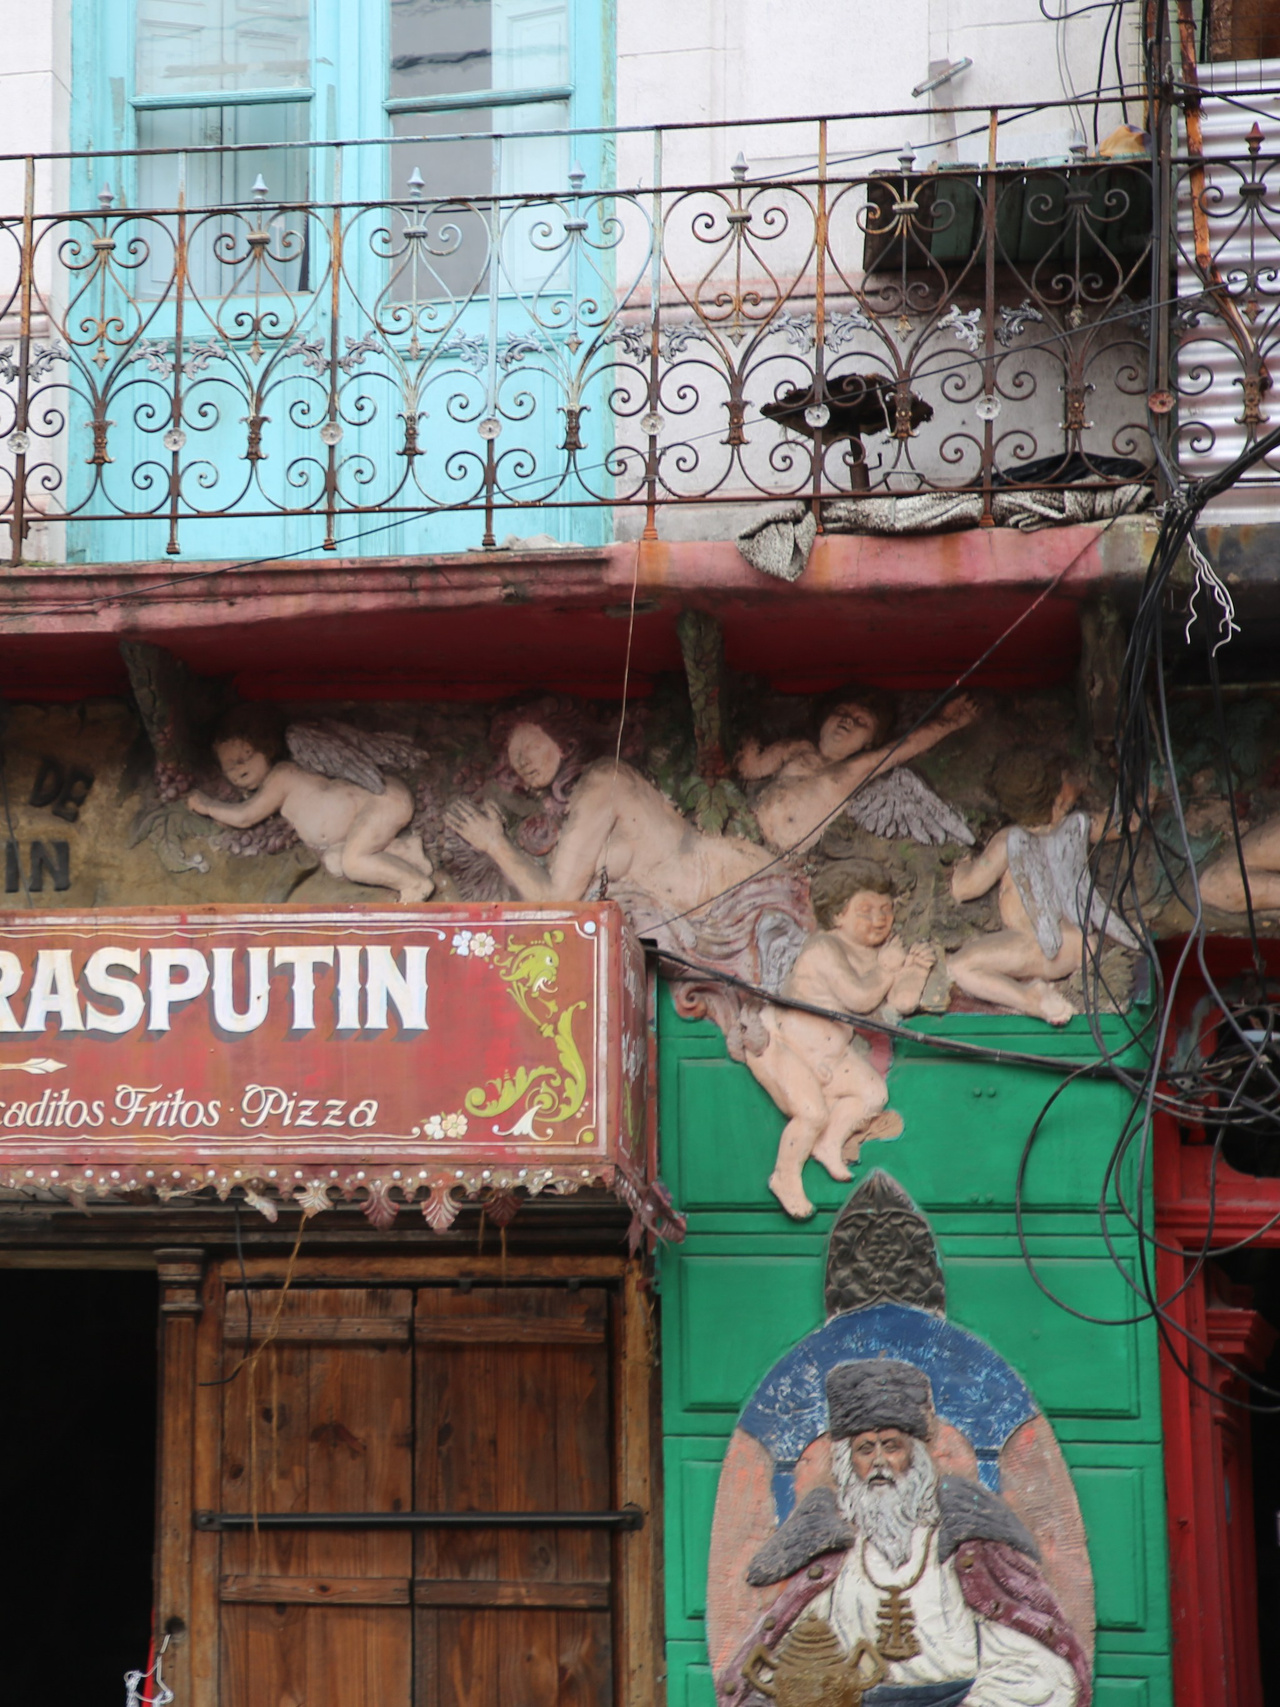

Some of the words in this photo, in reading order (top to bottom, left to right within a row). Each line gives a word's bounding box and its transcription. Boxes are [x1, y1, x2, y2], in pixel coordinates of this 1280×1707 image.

[29, 757, 94, 822] DE
[112, 1084, 222, 1128] Fritos
[239, 1086, 379, 1127] Pizza
